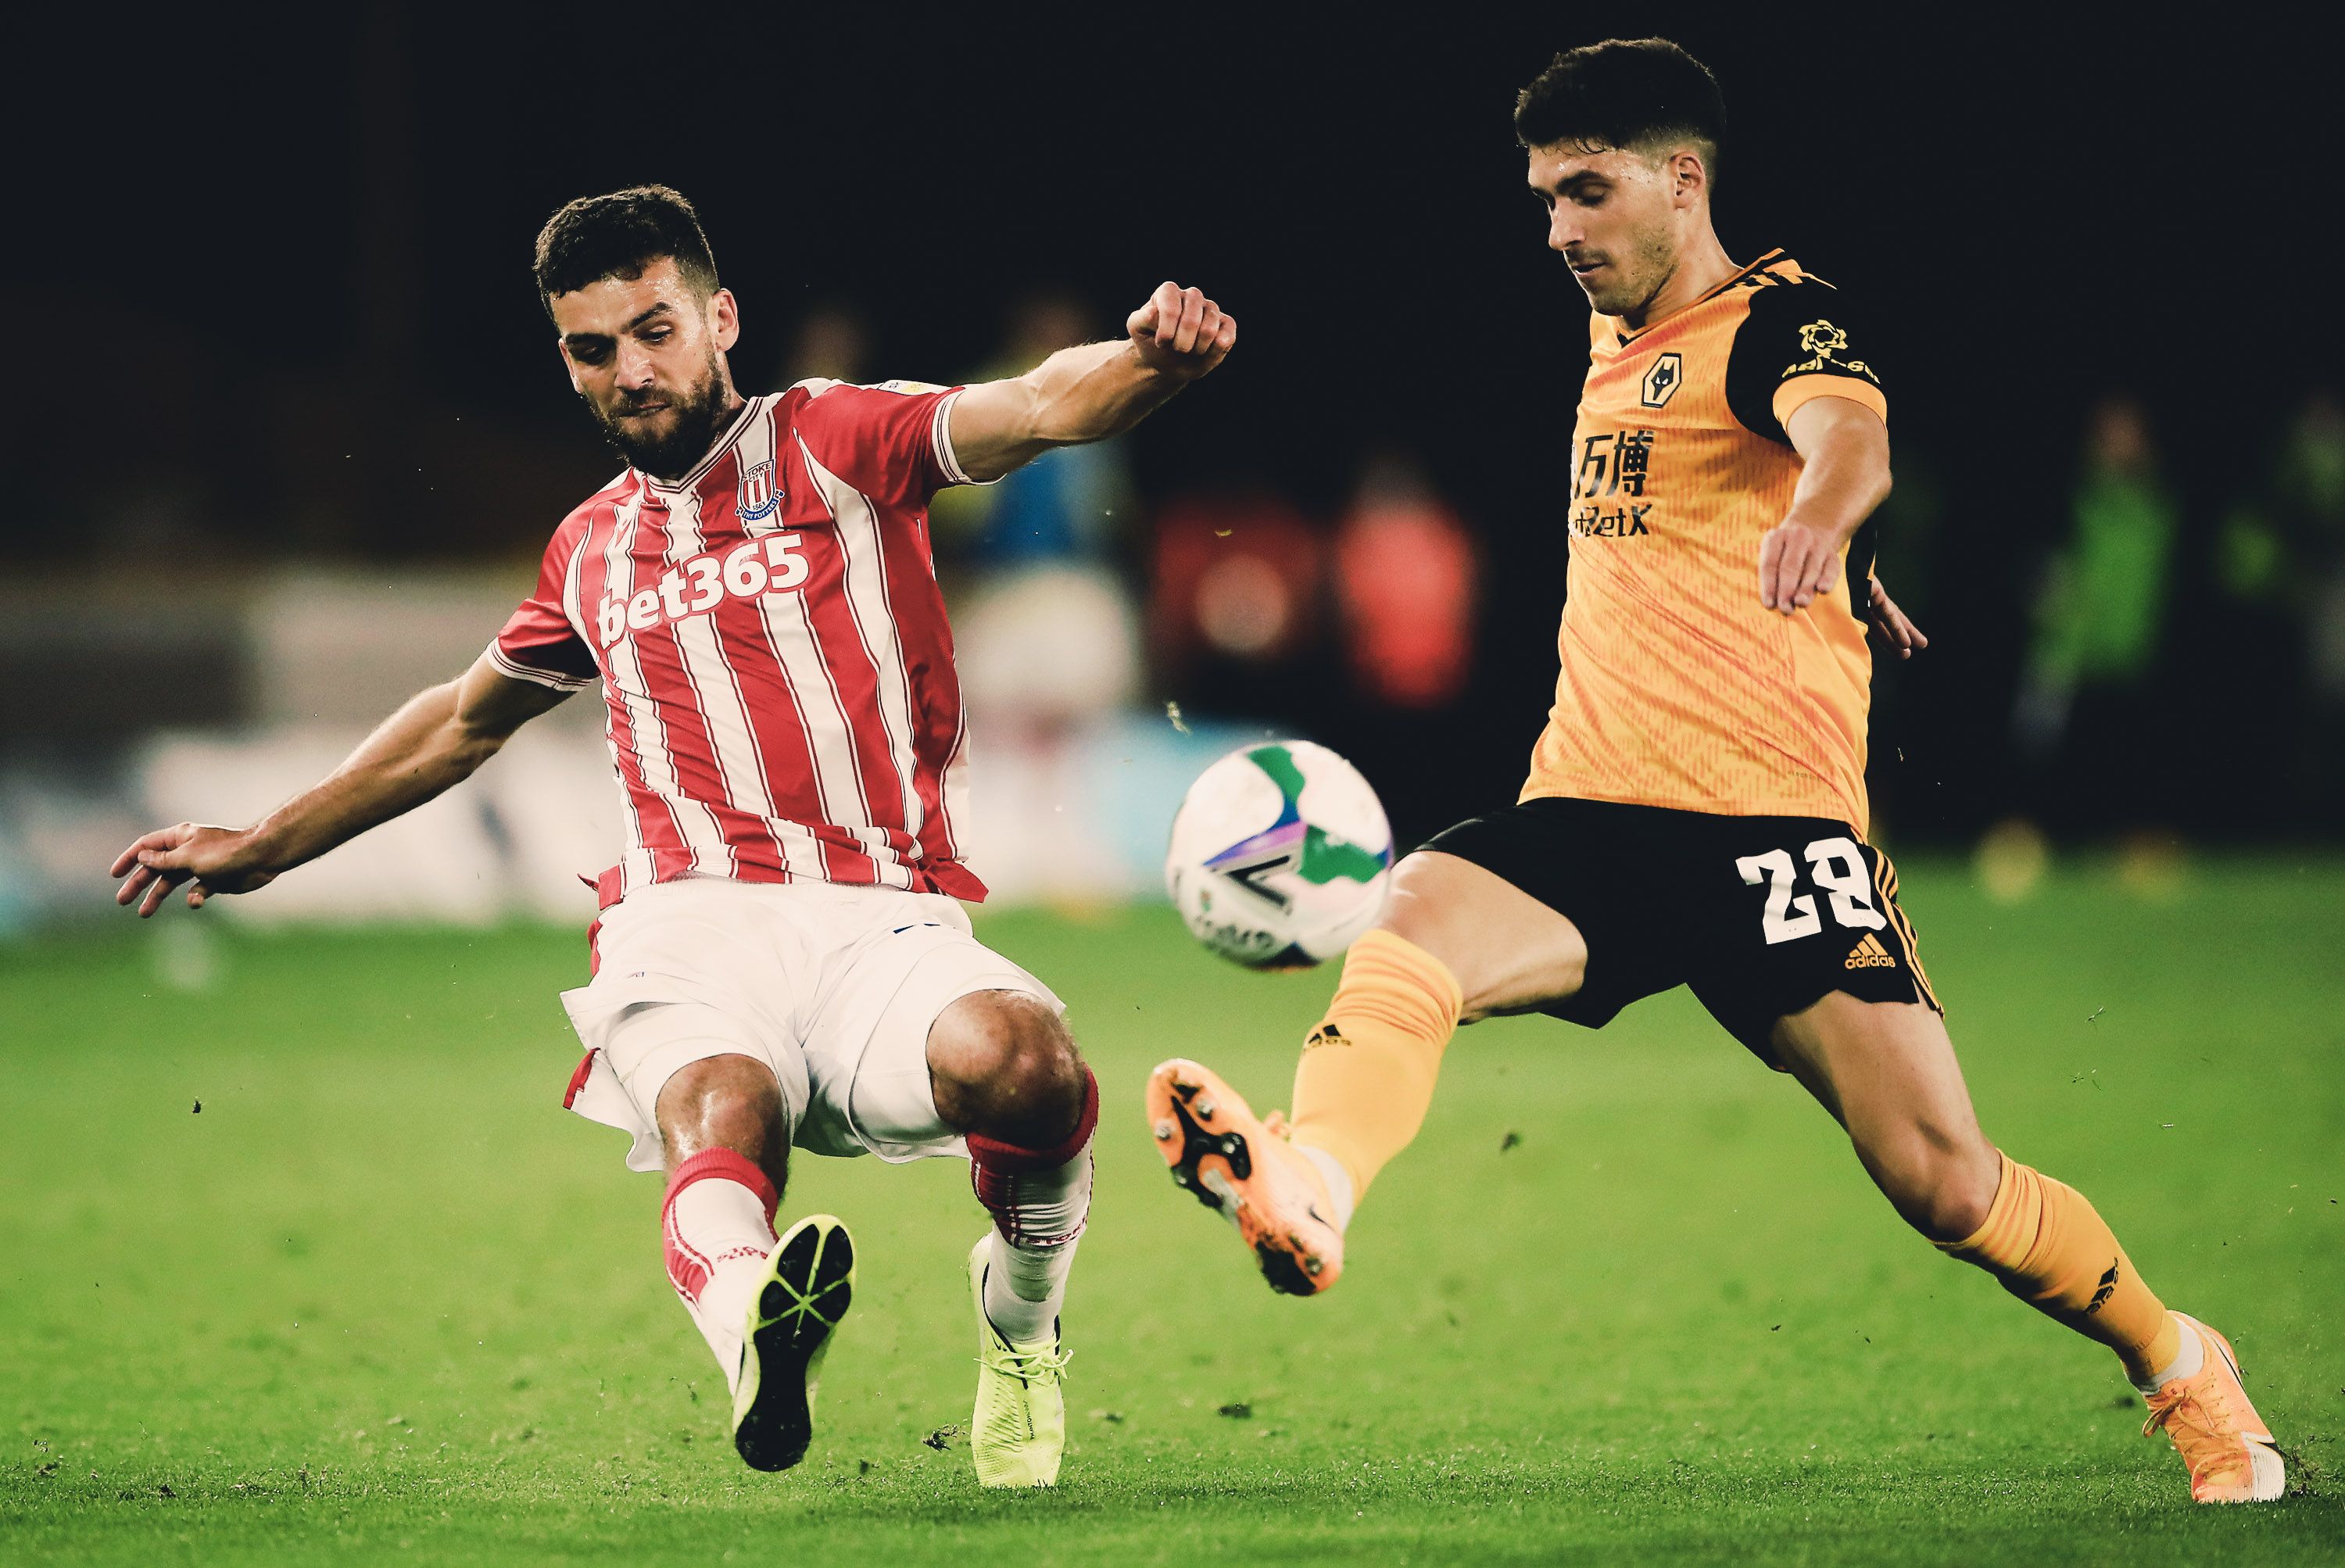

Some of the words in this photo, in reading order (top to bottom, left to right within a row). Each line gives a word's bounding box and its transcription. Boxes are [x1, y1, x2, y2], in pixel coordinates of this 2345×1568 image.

[743, 463, 772, 481] STOKE
[1574, 431, 1654, 499] 万博
[749, 473, 764, 482] CITY
[752, 502, 766, 510] 1863
[598, 534, 810, 650] bet365
[1735, 836, 1888, 944] 28
[1845, 954, 1896, 969] adidas
